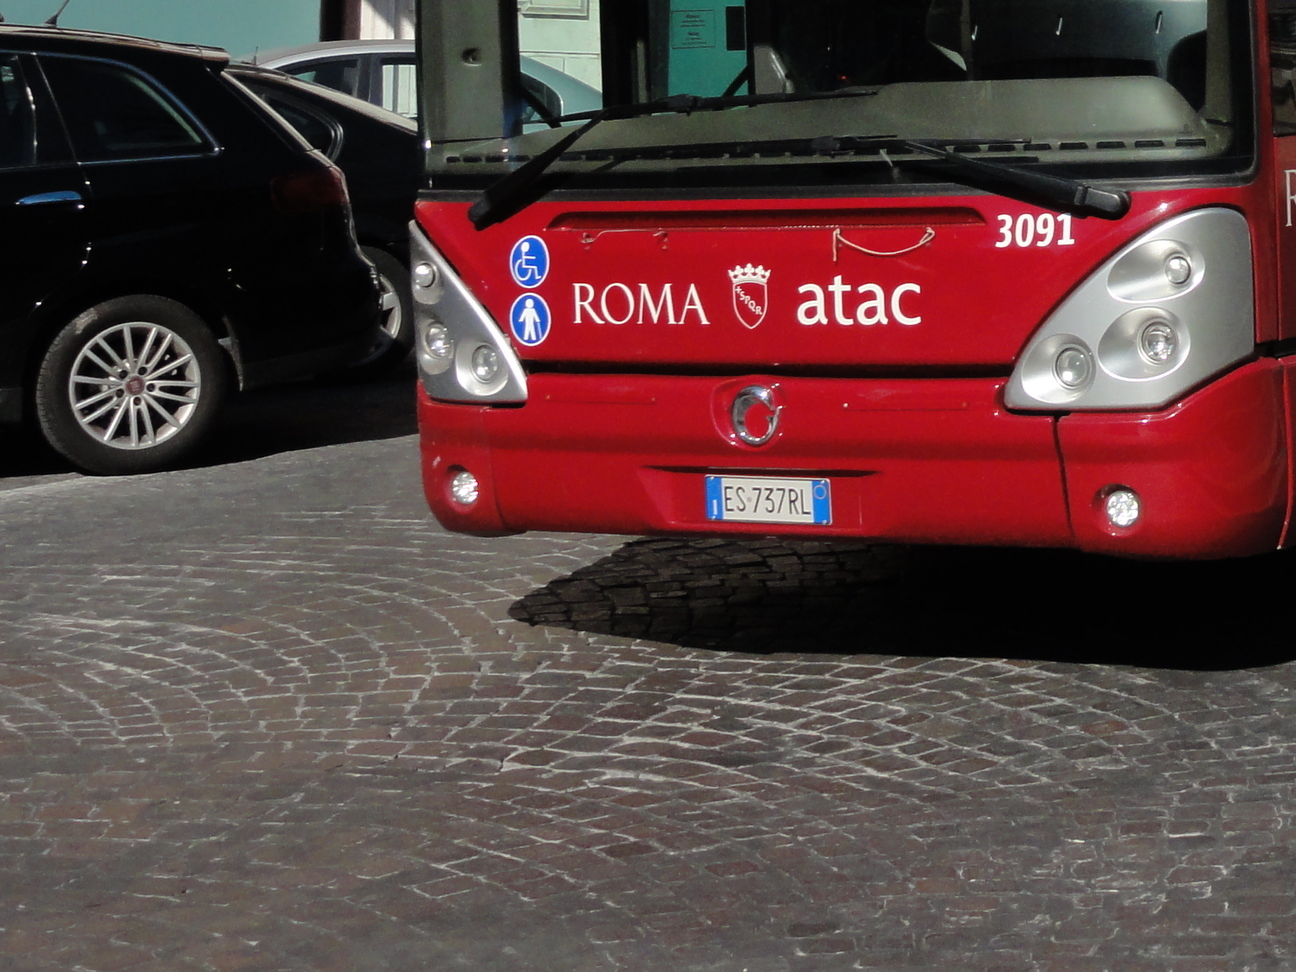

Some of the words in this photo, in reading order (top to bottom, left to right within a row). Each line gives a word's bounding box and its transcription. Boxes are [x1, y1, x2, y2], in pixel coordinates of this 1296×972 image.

[994, 212, 1076, 248] 3091
[572, 282, 711, 325] ROMA
[796, 274, 922, 326] atac
